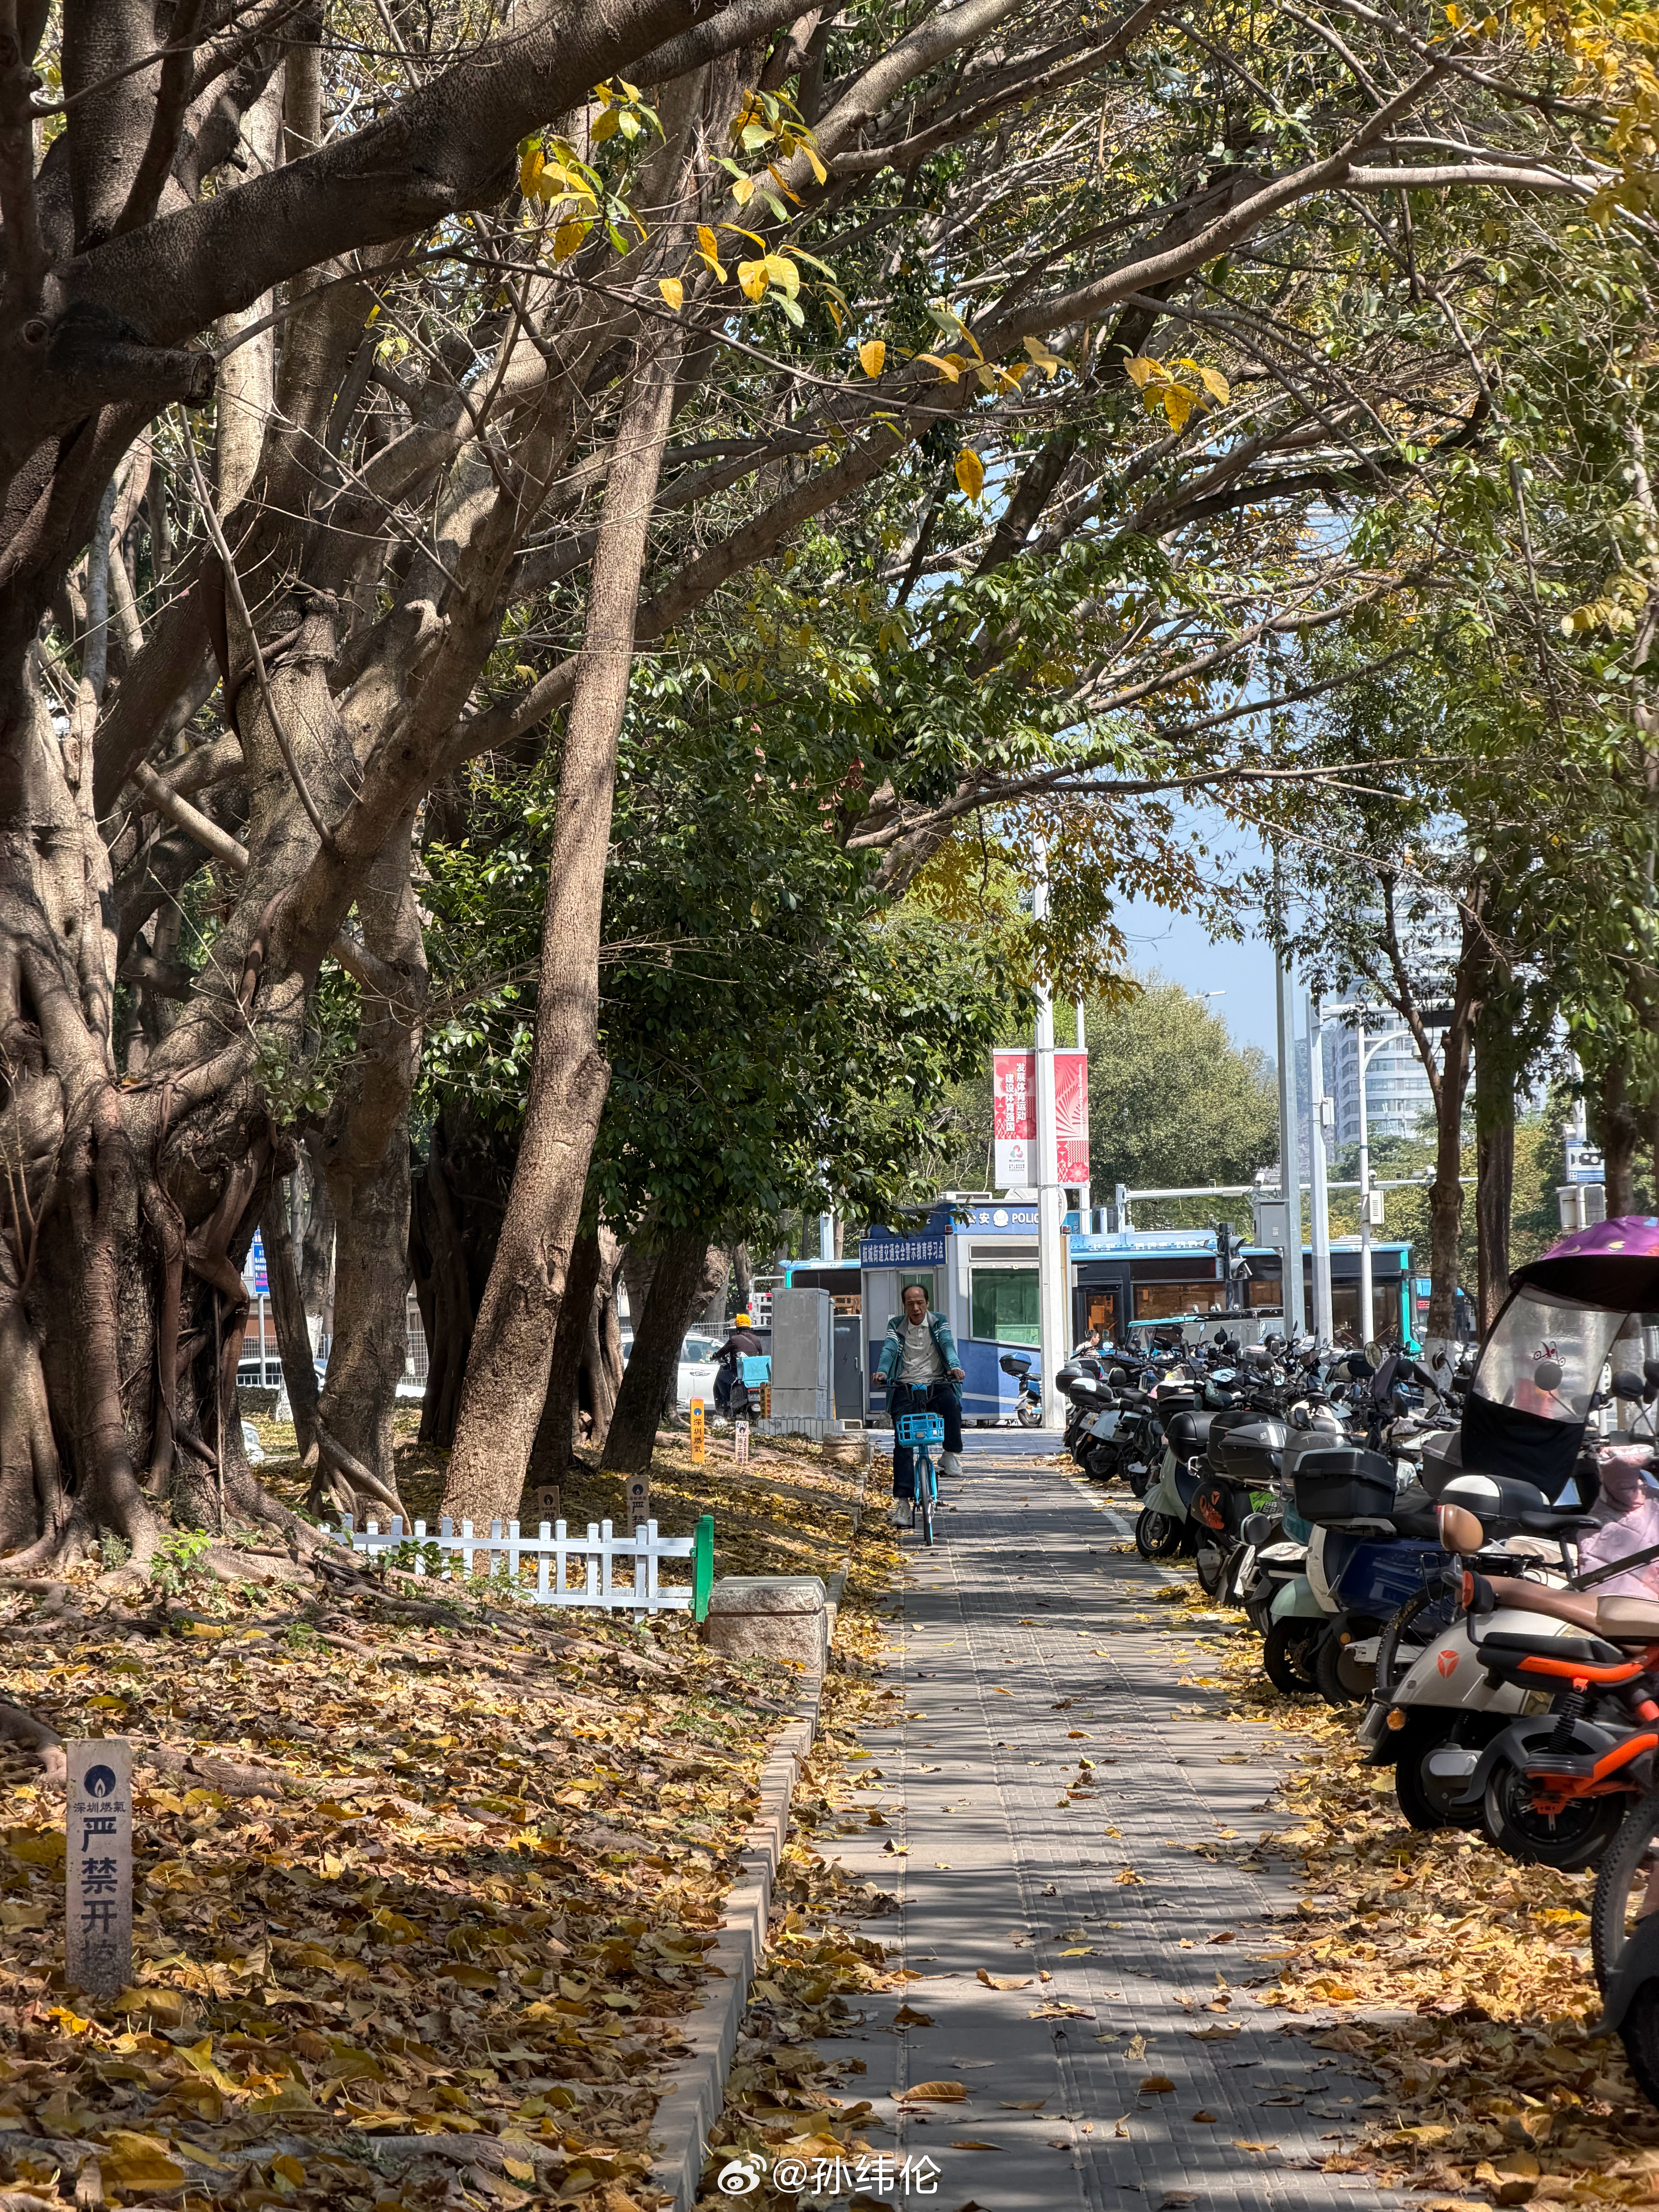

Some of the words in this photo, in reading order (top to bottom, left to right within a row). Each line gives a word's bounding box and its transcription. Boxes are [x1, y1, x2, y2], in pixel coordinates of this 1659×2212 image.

[1005, 1073, 1015, 1132] 建设体育强国
[1017, 1062, 1026, 1121] 发展体育运动
[1012, 1212, 1039, 1223] POLIC
[862, 1240, 944, 1263] 航城街道交通安全警示教育学习点
[1394, 1601, 1418, 1630] KENDA
